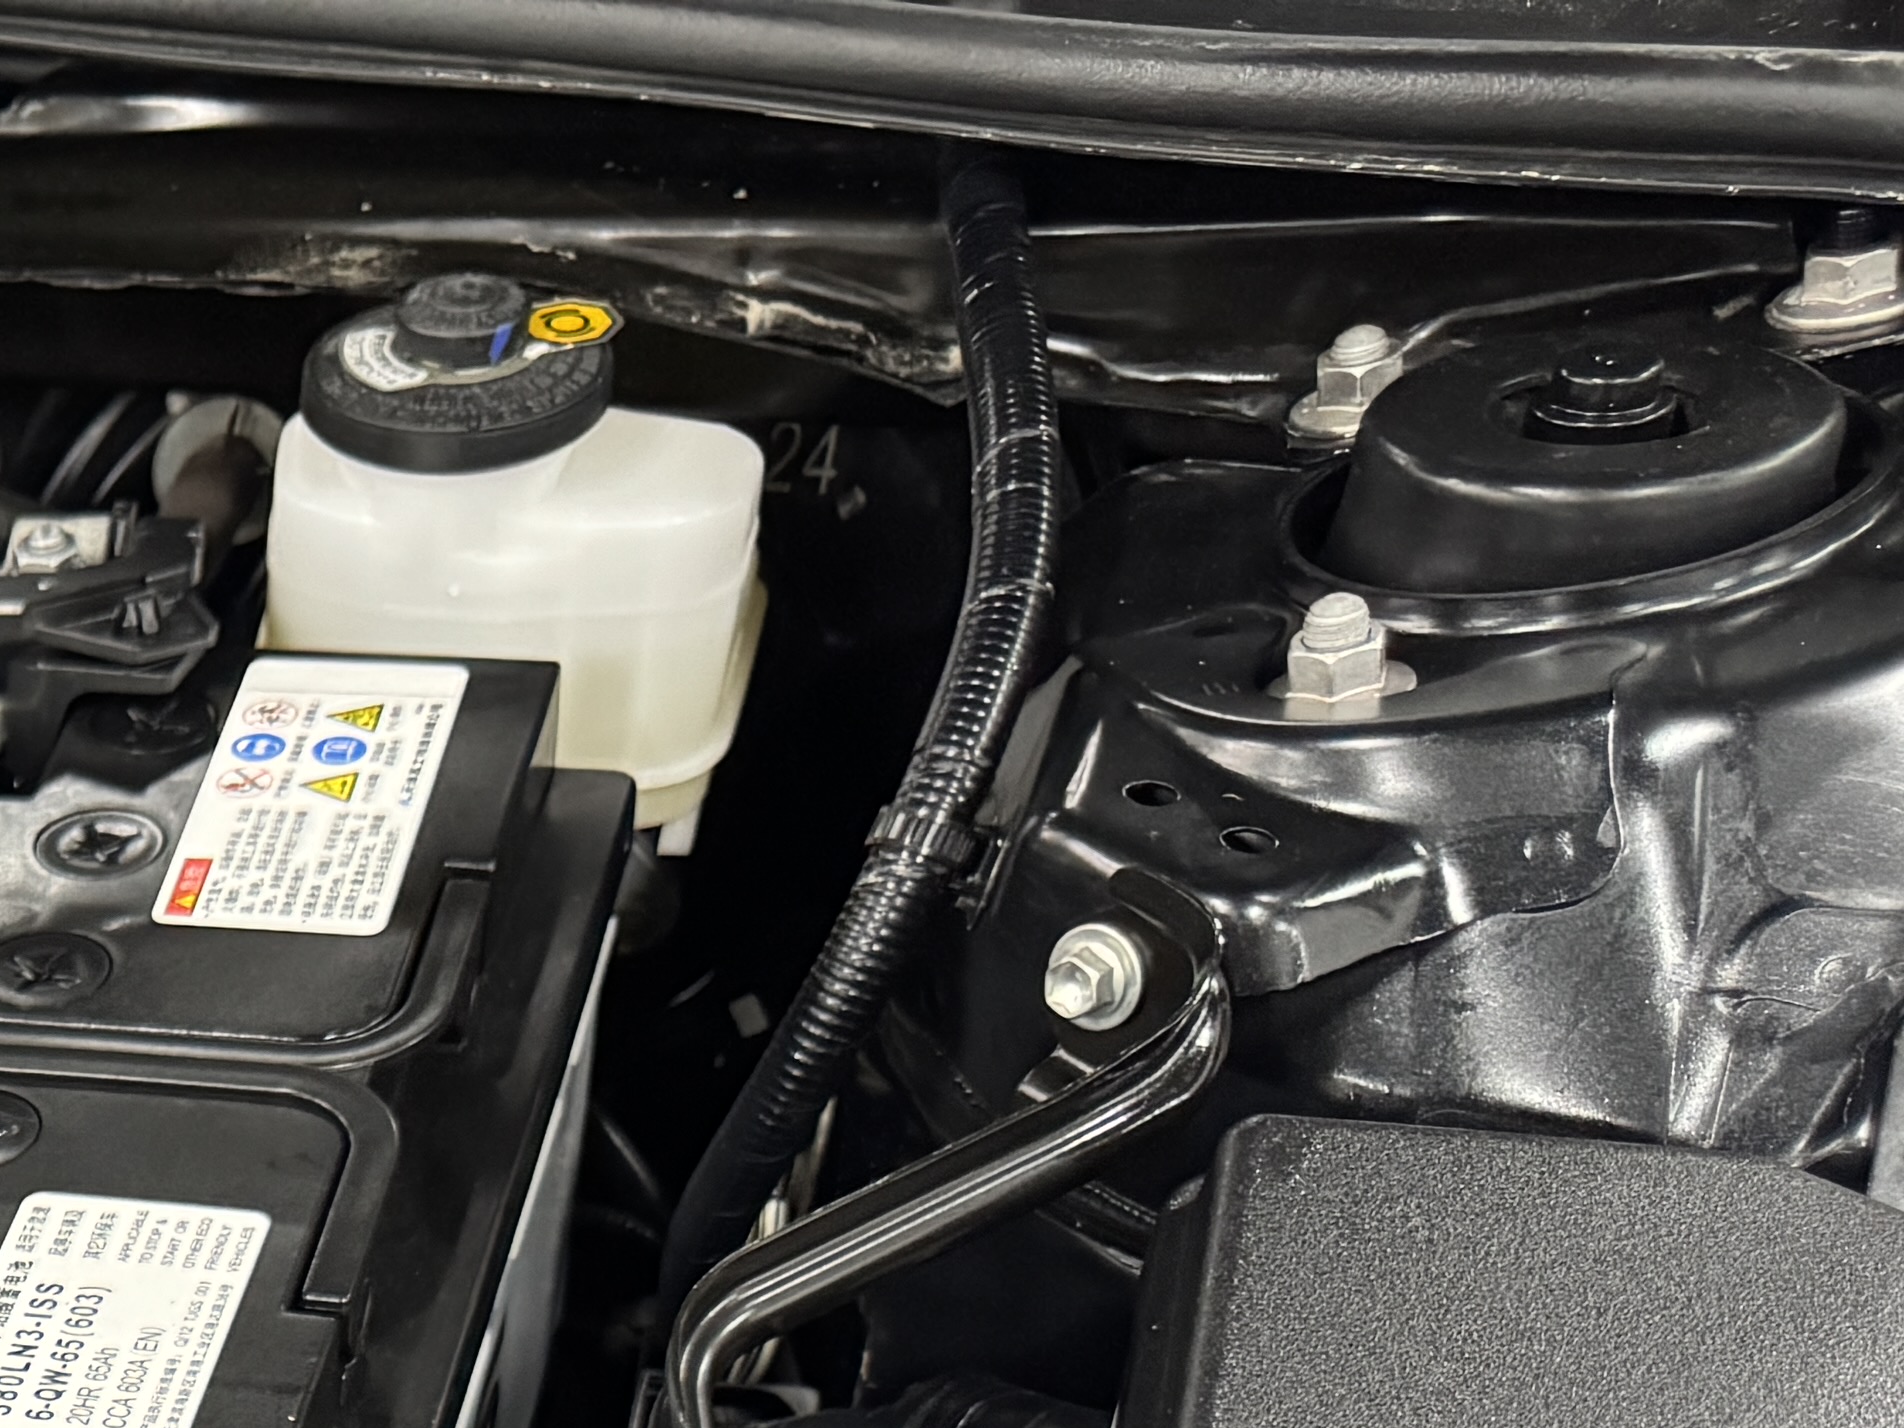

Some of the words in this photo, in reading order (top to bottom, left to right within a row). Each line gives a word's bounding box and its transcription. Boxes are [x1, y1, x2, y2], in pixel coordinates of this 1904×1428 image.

[24, 1286, 112, 1420] 6-QW-65(603)
[65, 1386, 102, 1425] 20HR
[84, 1347, 119, 1381] 65Ah
[102, 1397, 136, 1428] CCA
